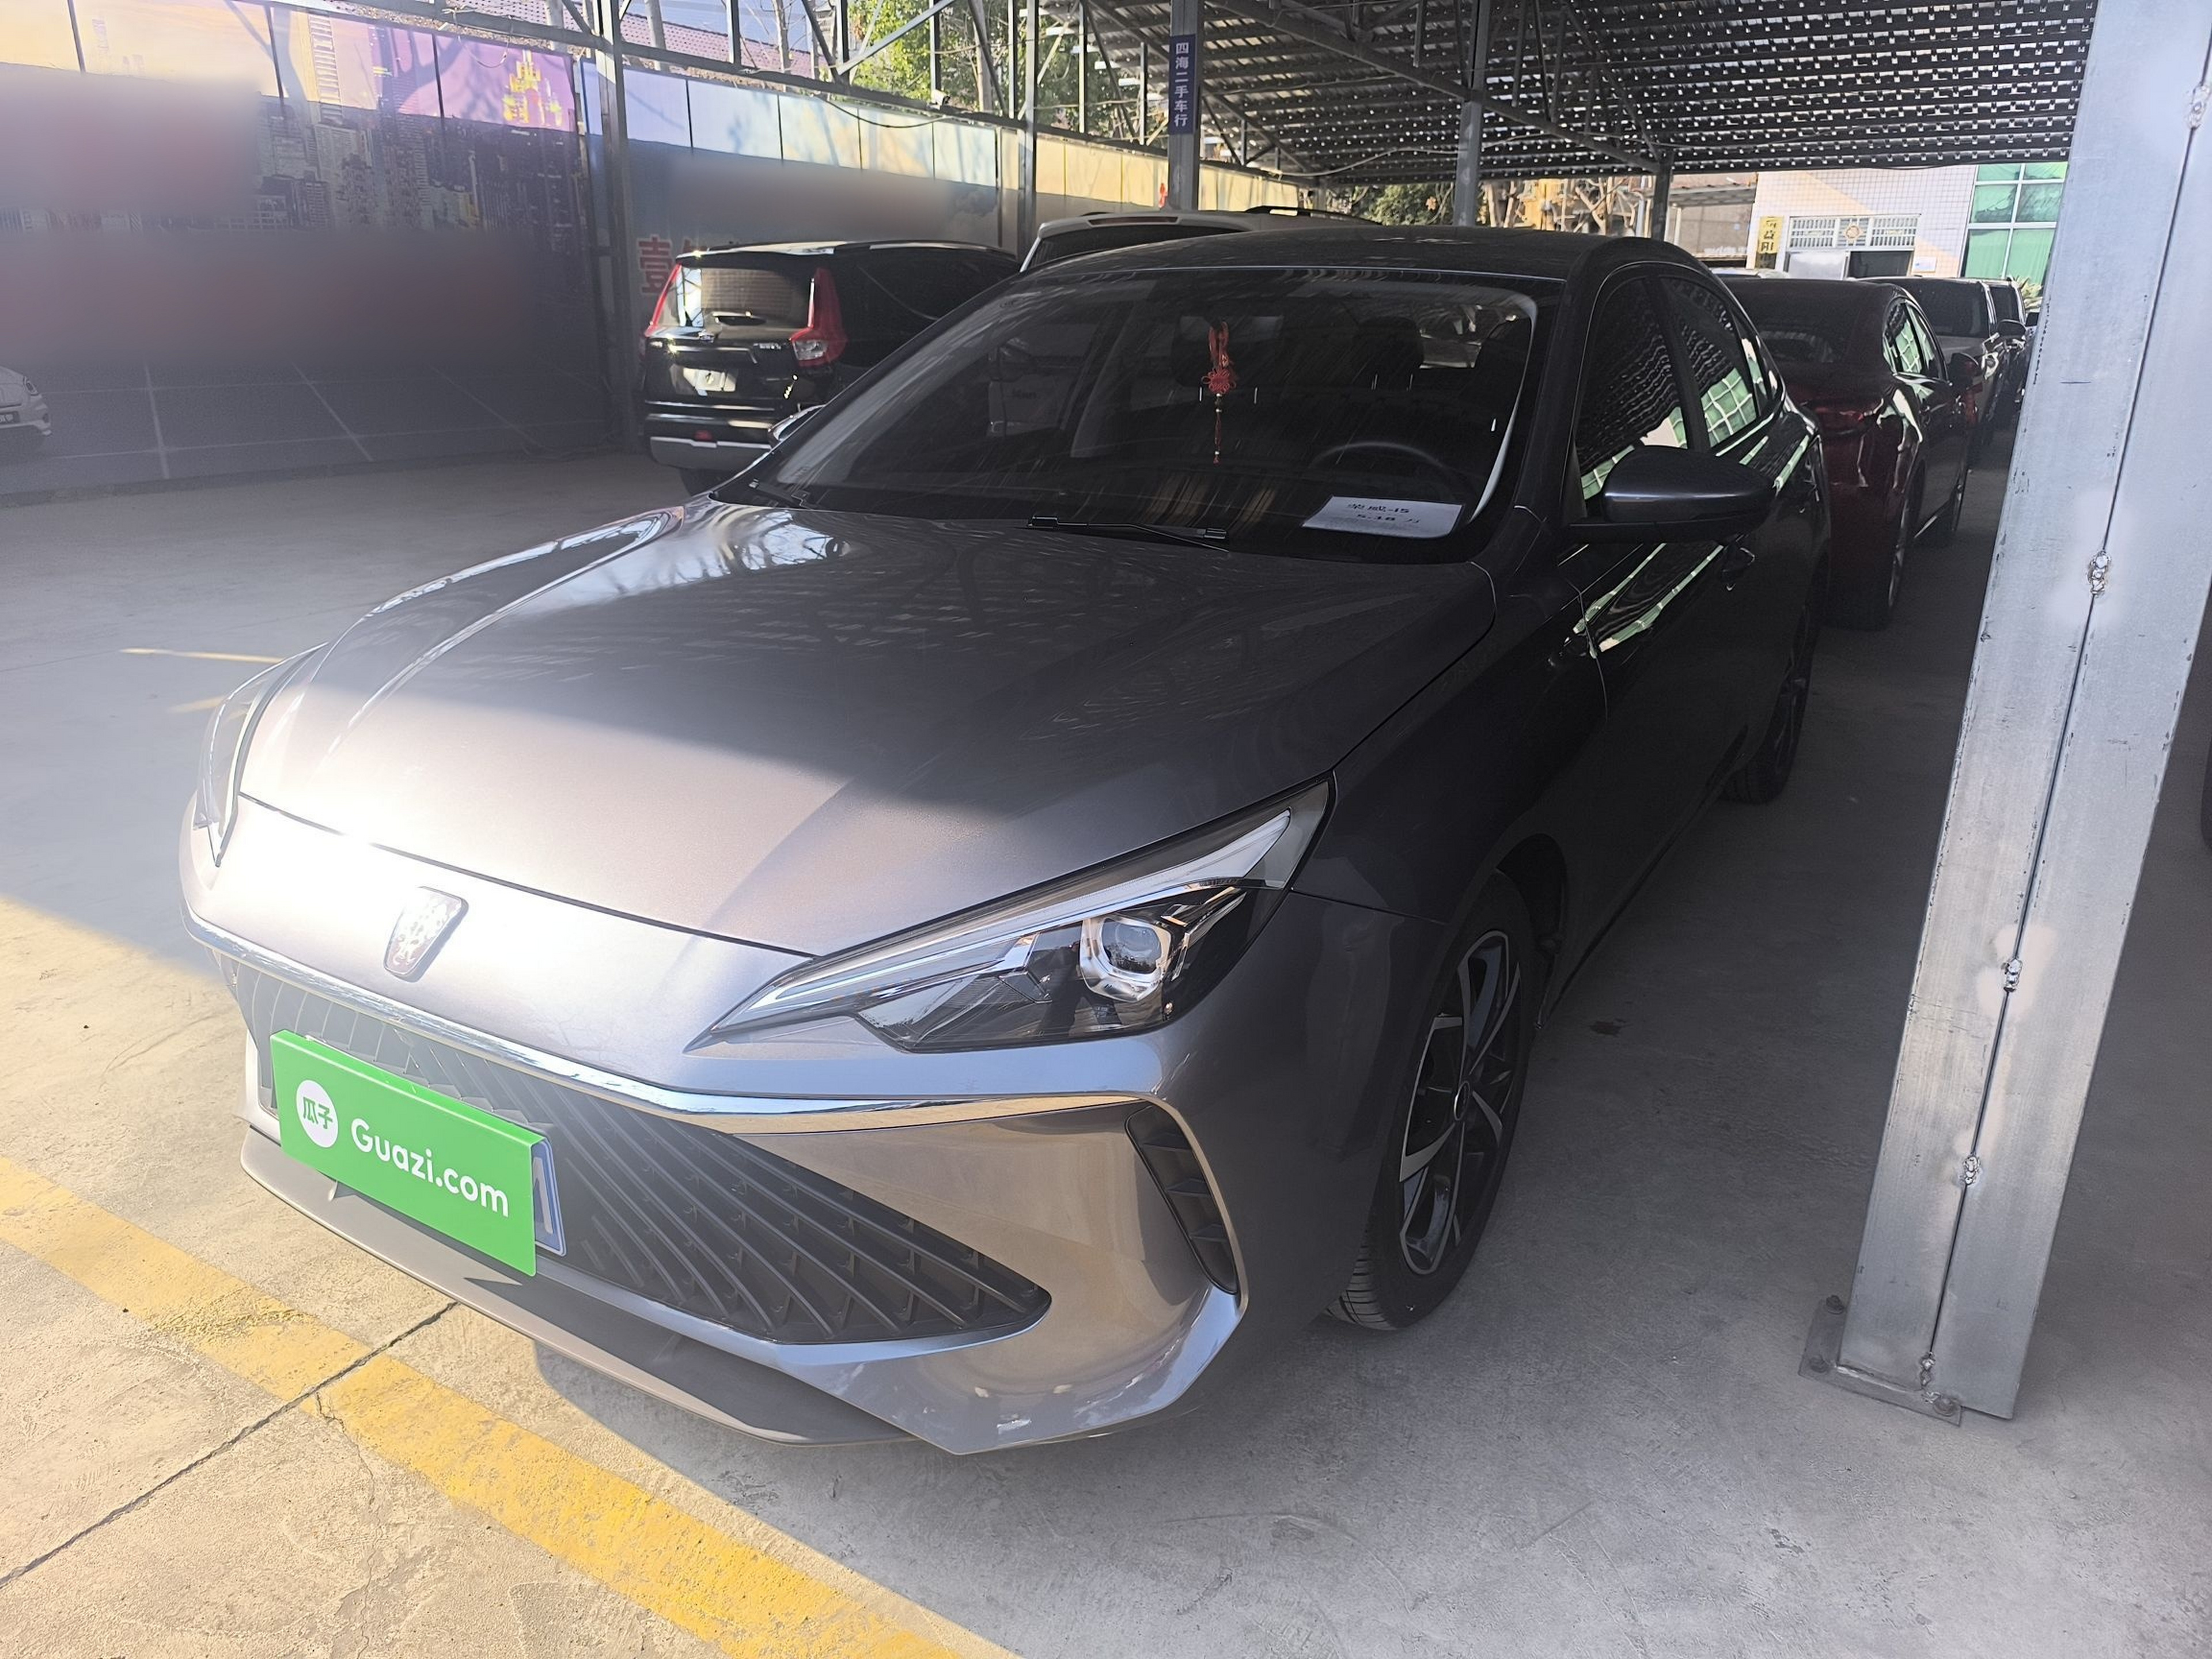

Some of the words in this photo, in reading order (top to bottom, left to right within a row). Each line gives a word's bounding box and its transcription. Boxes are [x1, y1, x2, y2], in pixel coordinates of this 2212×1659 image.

[1174, 42, 1189, 127] 四海二手车行
[303, 1096, 333, 1130] 瓜子
[351, 1118, 509, 1218] Guazi.com
